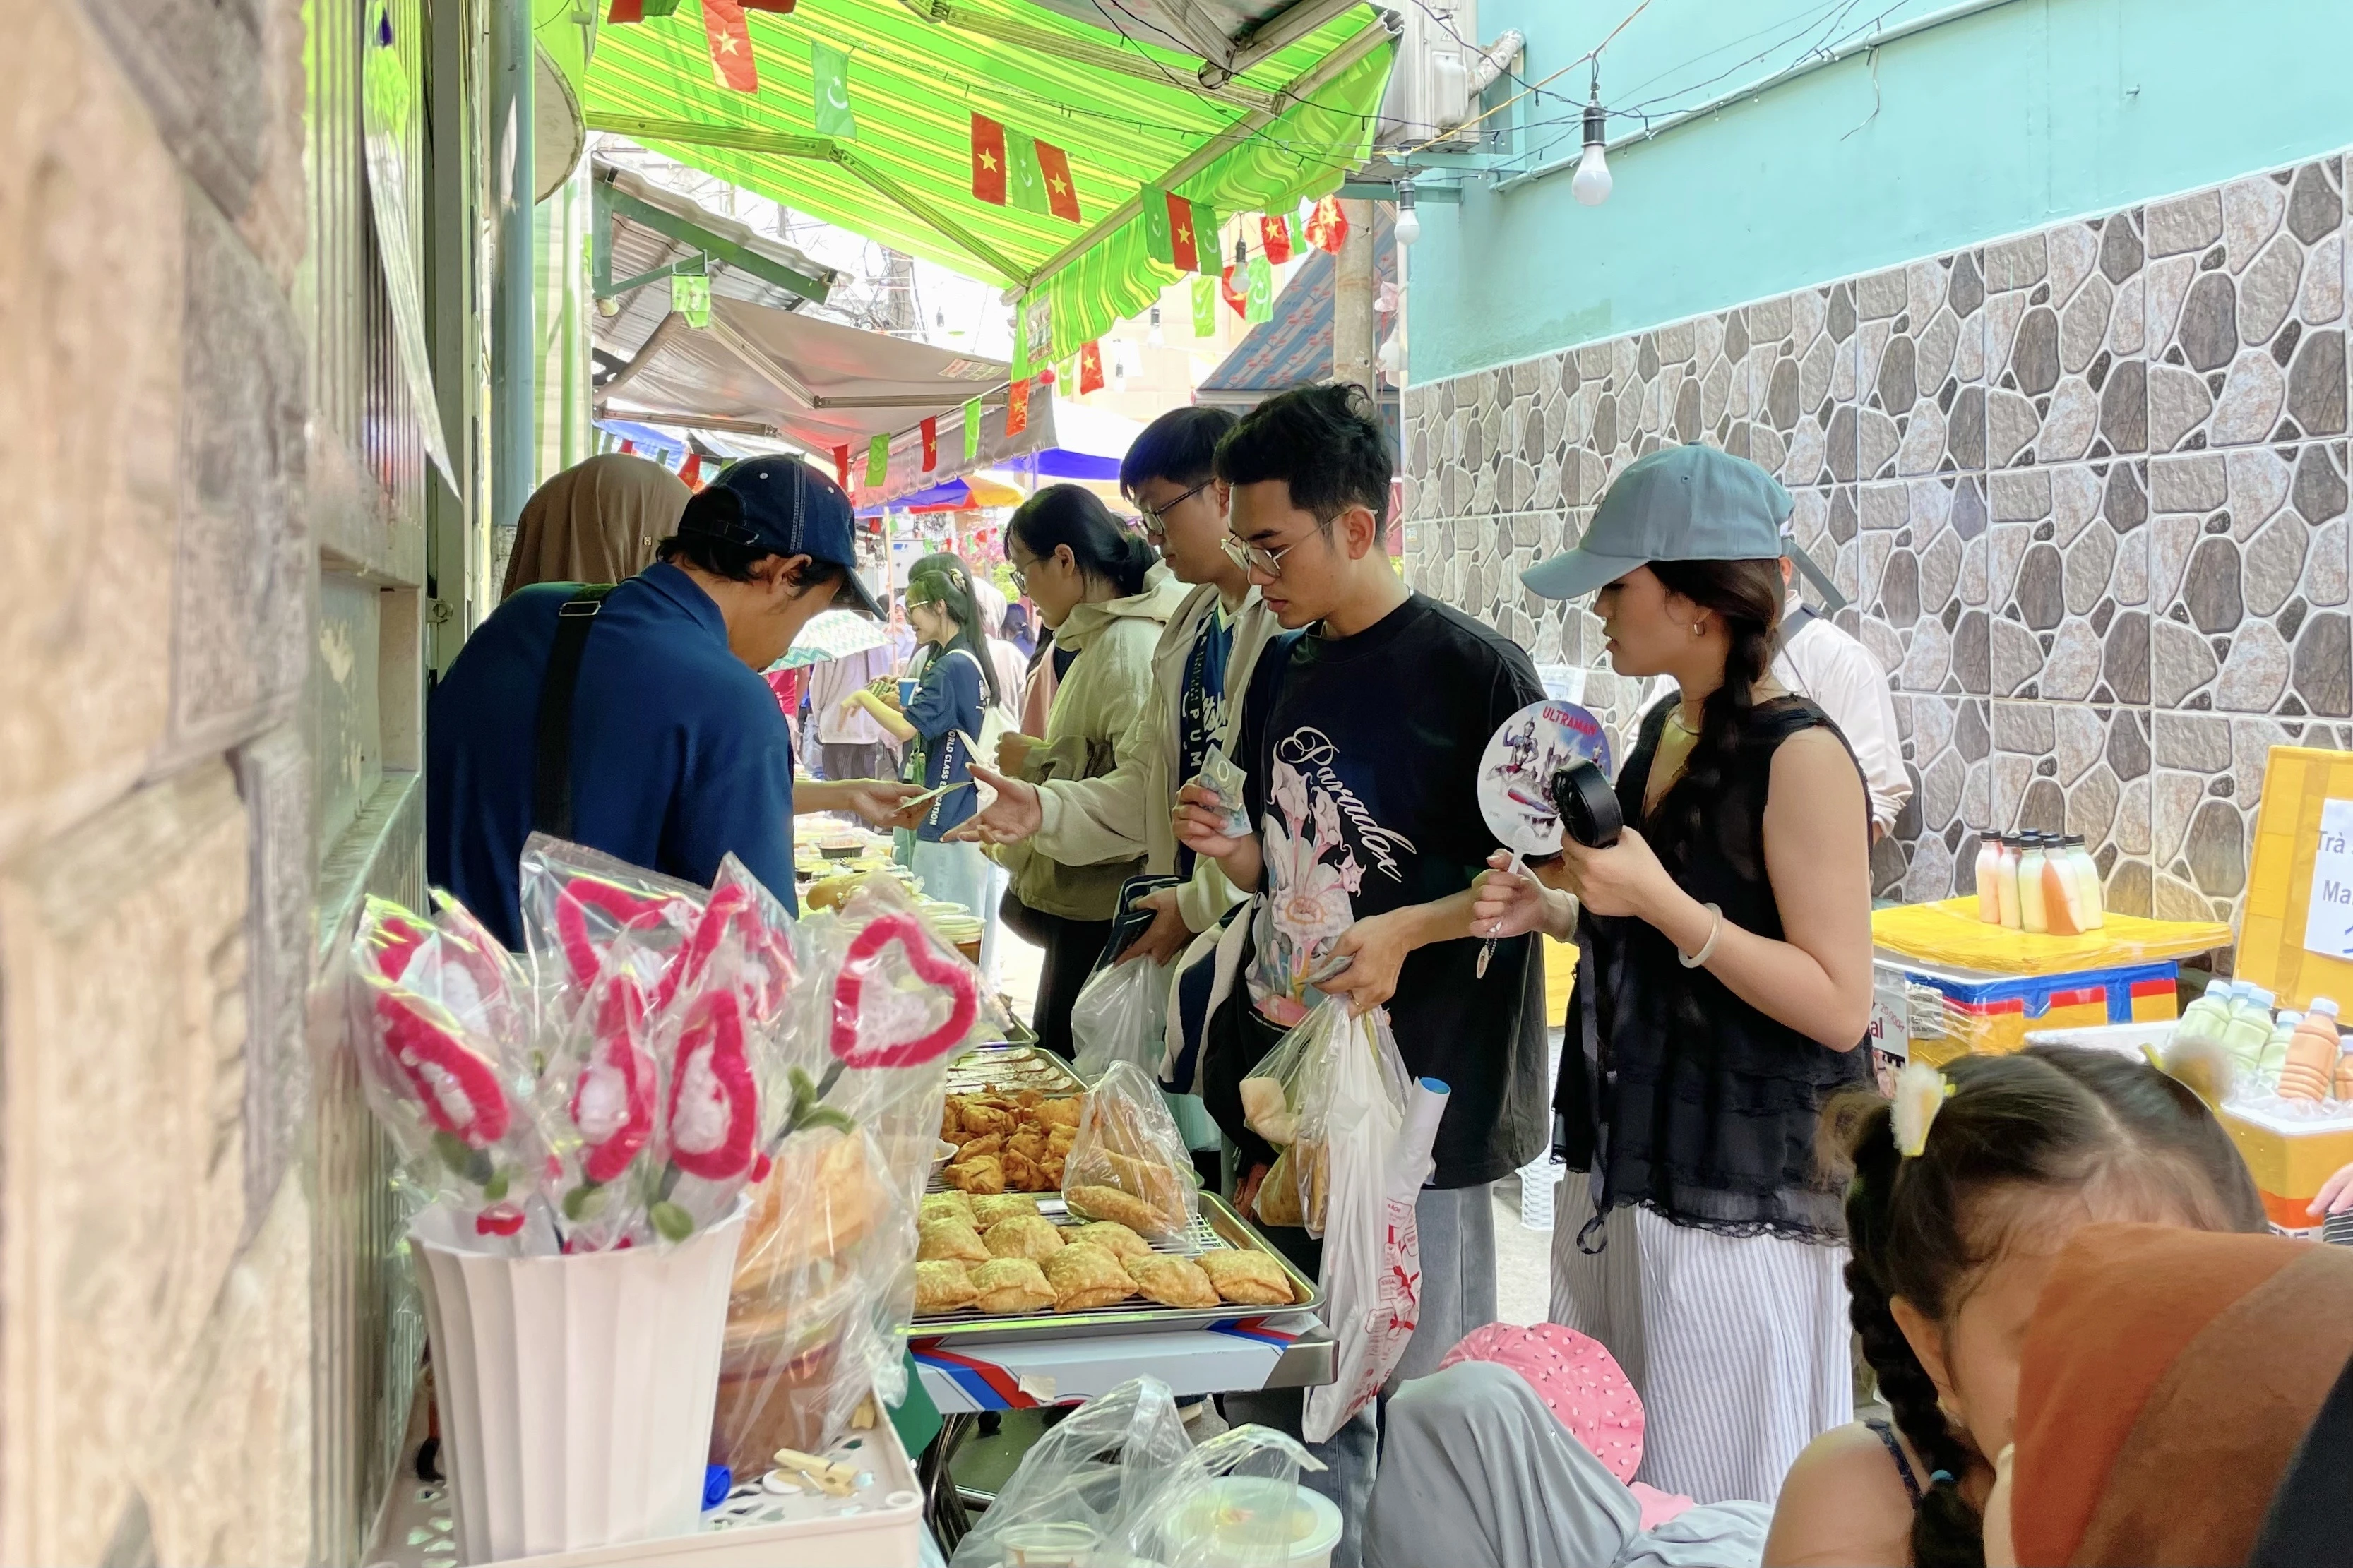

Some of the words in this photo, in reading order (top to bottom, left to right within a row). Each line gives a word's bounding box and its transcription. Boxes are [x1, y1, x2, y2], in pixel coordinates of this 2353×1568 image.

[1542, 705, 1597, 736] ULTRAMAN
[946, 728, 957, 753] ORLD
[941, 753, 953, 779] CLASS
[929, 779, 948, 826] ECATION
[2316, 830, 2345, 854] Trà
[2323, 880, 2353, 906] Ma
